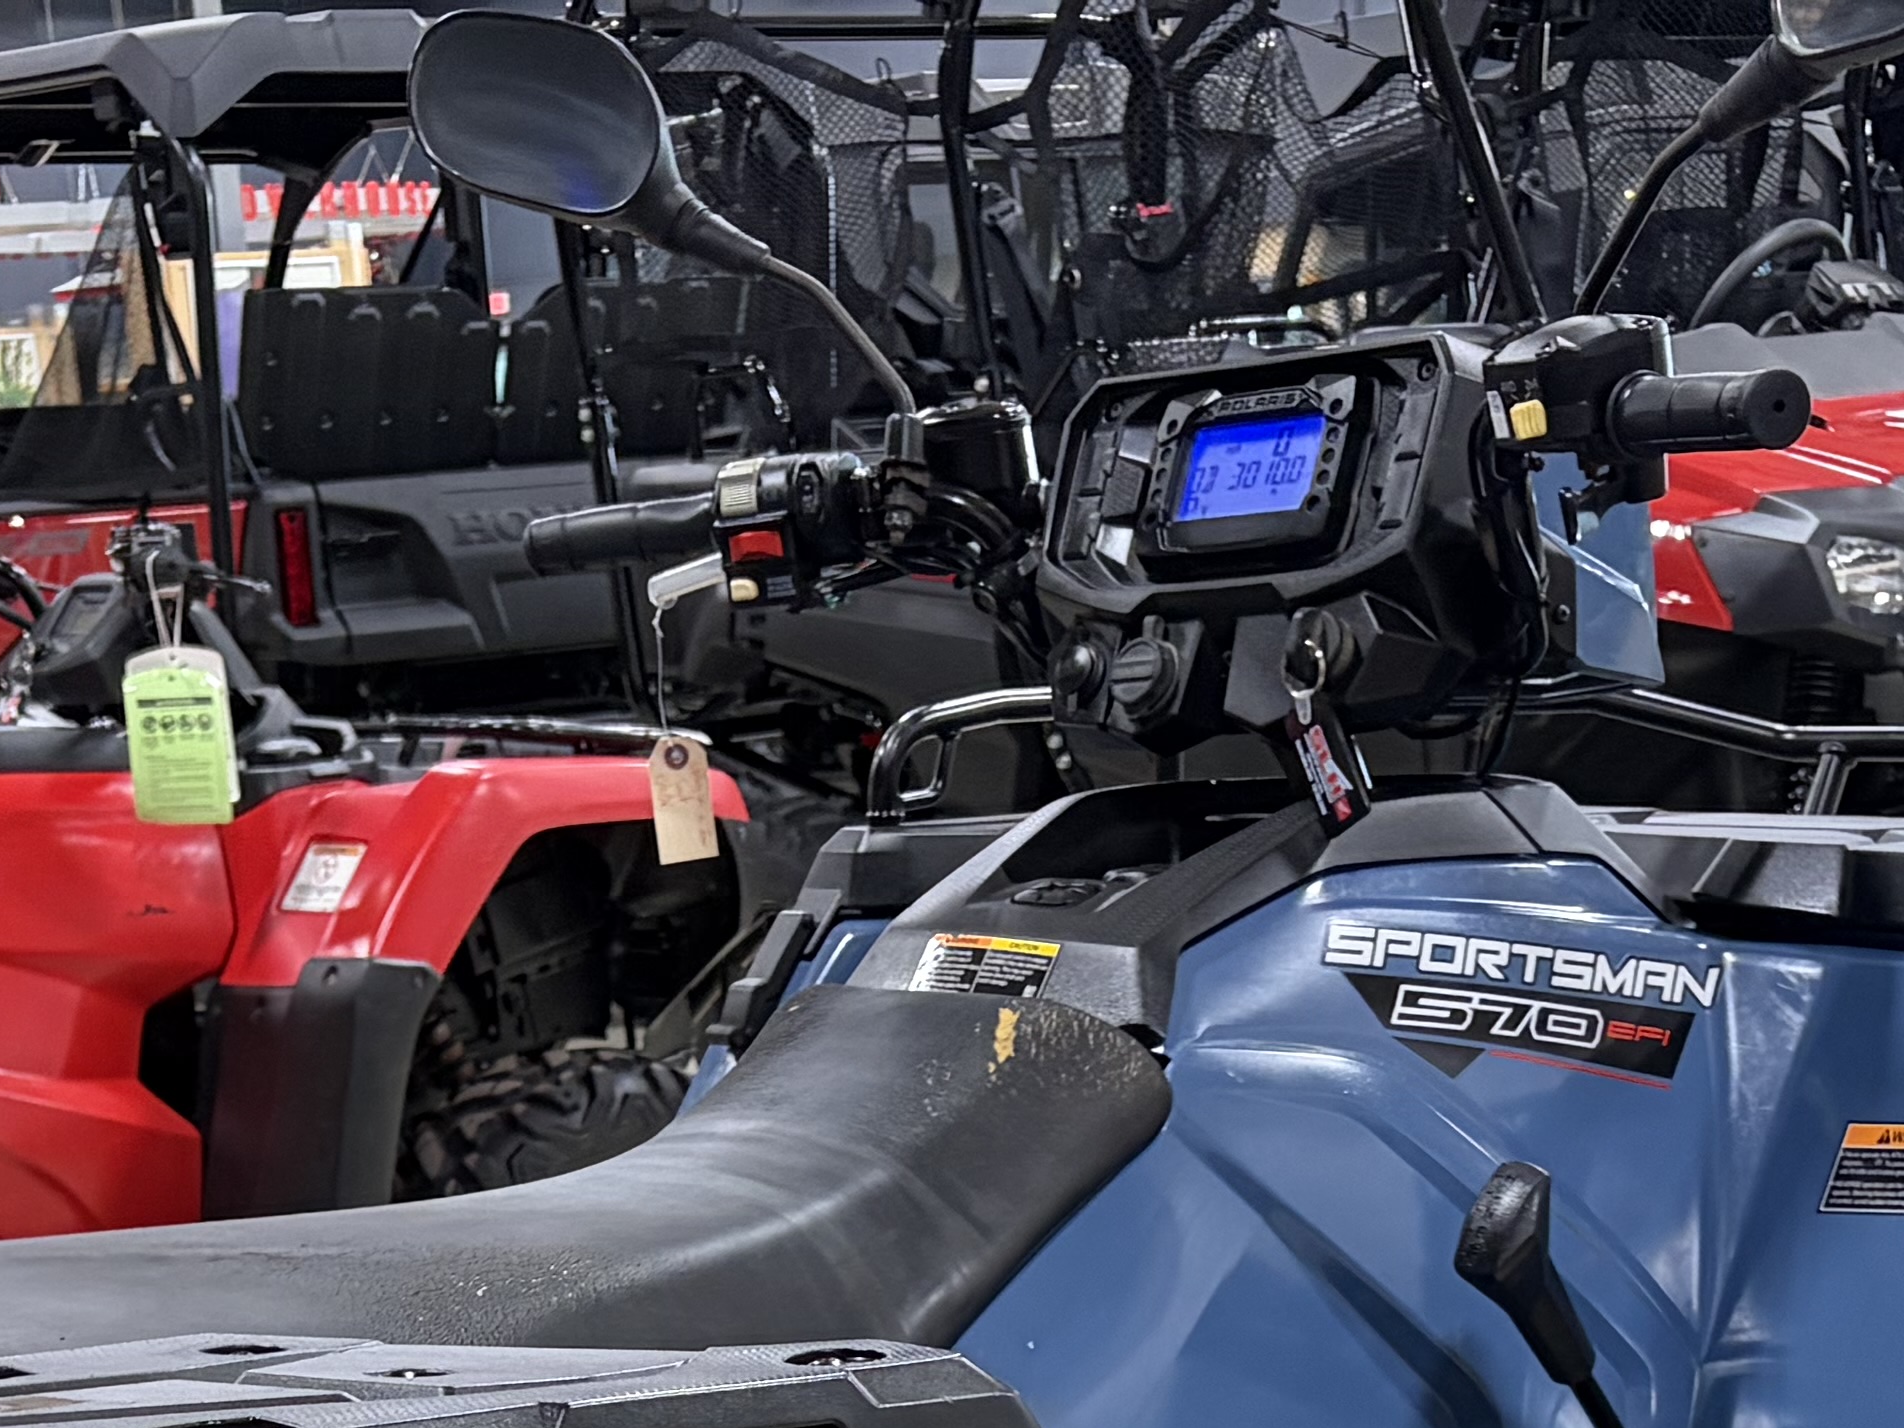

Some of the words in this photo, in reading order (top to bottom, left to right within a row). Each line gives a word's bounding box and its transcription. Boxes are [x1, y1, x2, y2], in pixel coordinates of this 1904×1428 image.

[1217, 393, 1297, 413] POLARIS
[1008, 941, 1040, 951] CAUTION
[1324, 926, 1721, 1008] SPORTSMAN
[1390, 983, 1605, 1050] 570
[1606, 1019, 1672, 1048] EFI
